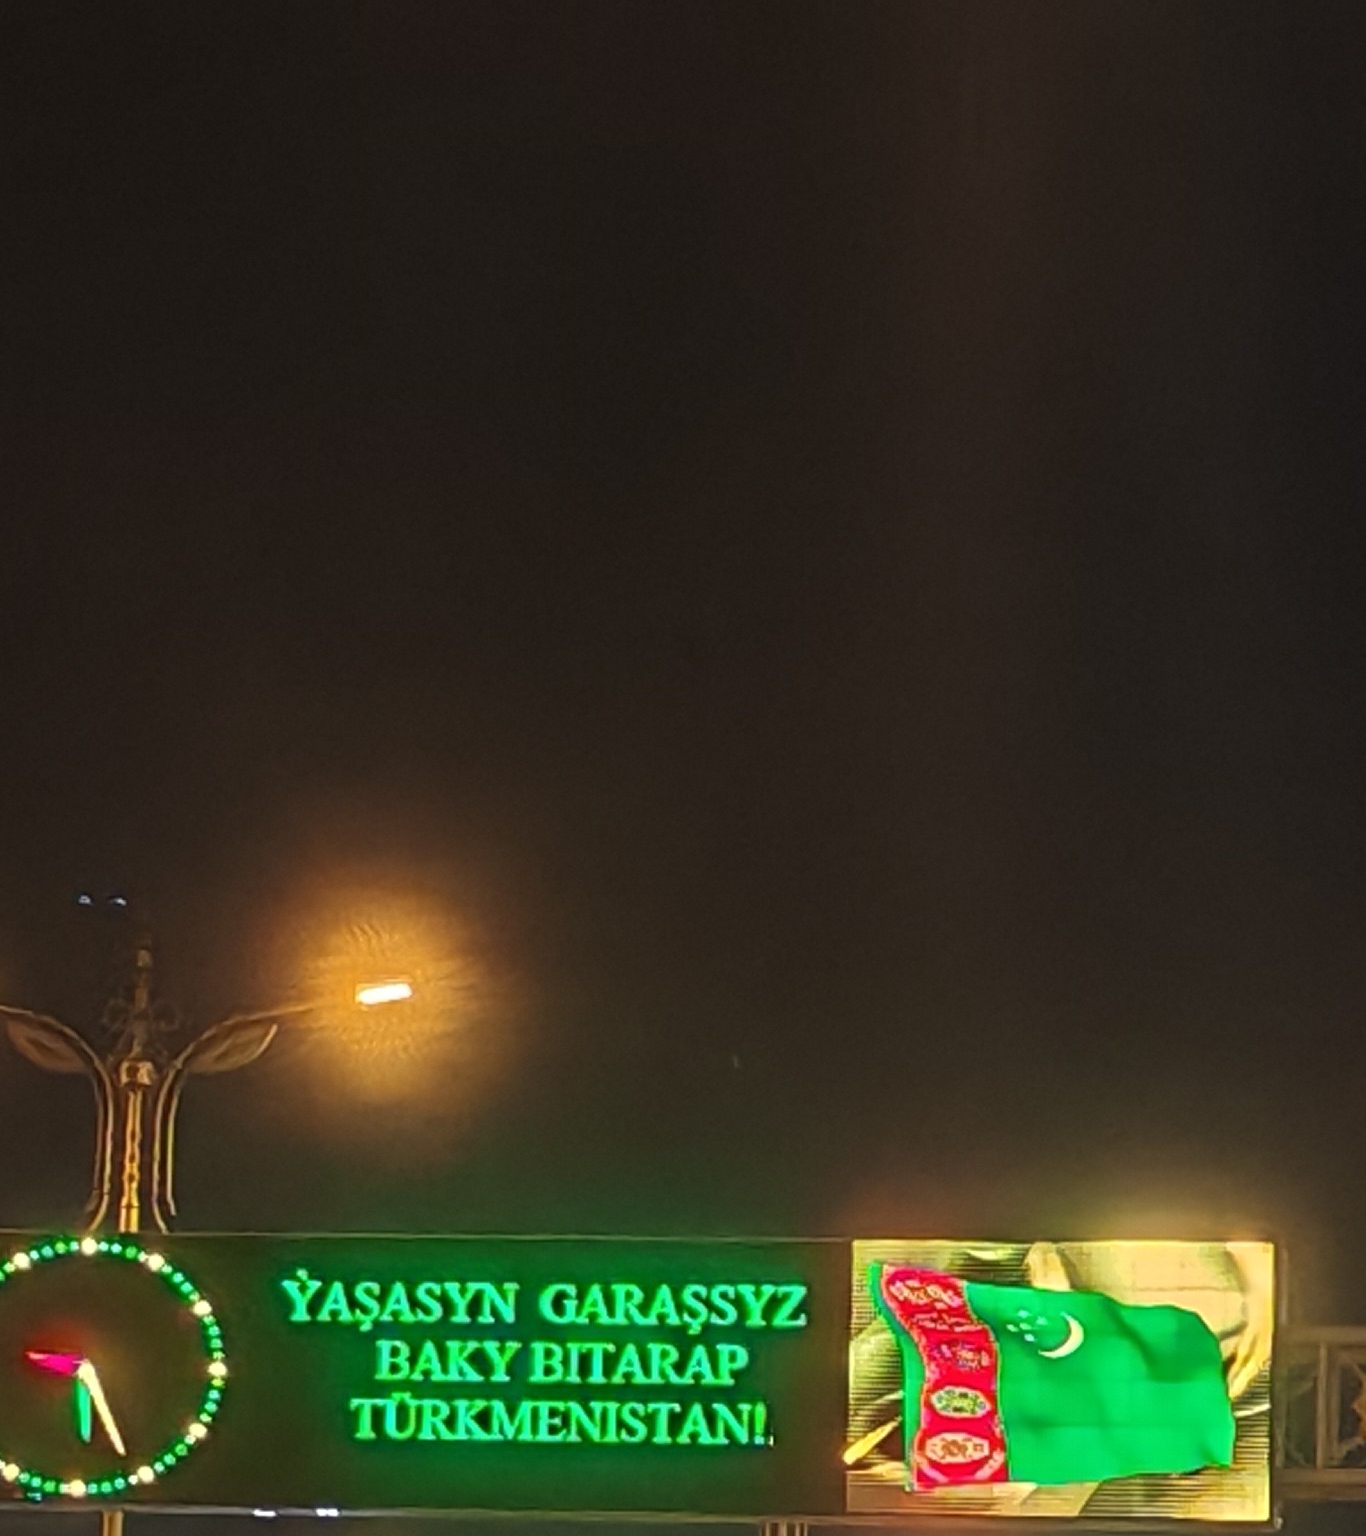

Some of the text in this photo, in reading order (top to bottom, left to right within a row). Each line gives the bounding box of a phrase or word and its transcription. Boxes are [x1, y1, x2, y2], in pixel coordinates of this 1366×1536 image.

[538, 1283, 807, 1335] GARAŞSYZ
[375, 1340, 748, 1386] BAKY BITARAP
[350, 1391, 767, 1445] TÜRKMENISTAN!
